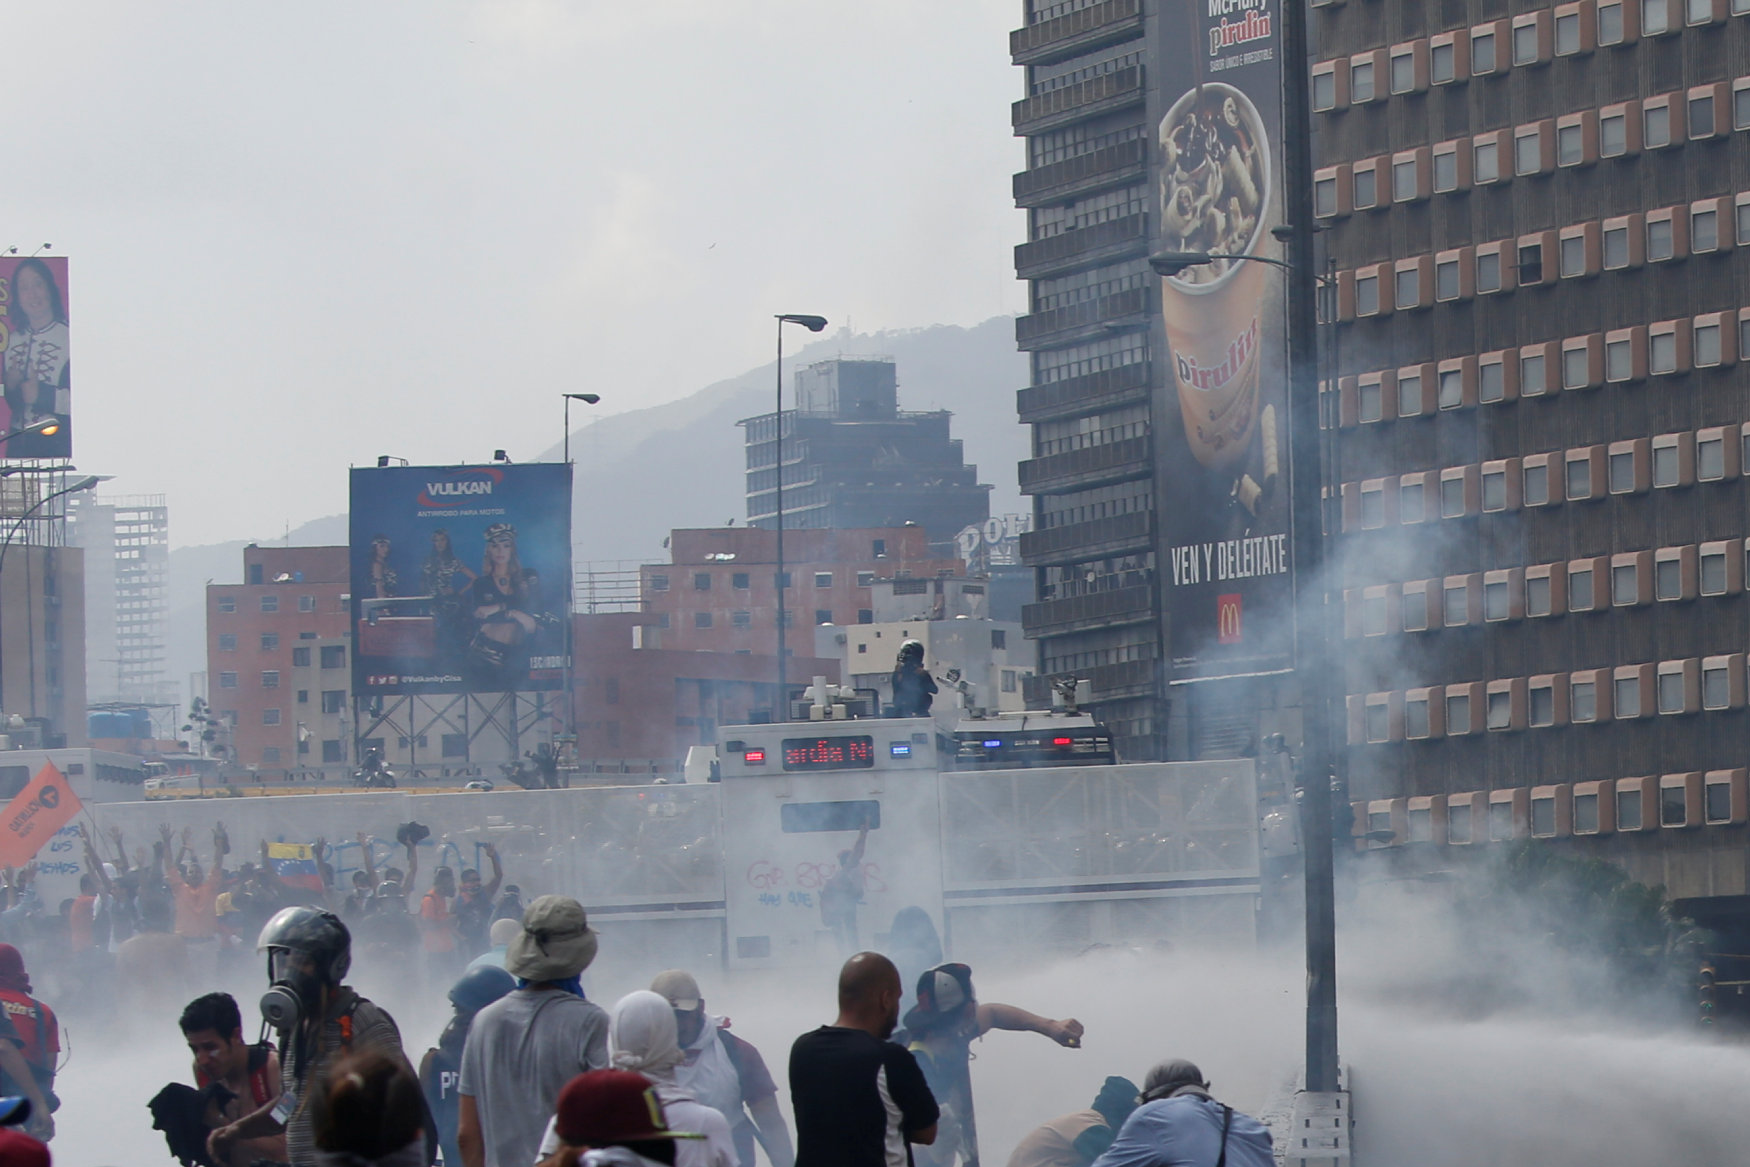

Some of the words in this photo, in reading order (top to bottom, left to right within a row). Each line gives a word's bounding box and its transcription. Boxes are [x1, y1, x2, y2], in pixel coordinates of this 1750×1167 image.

[1210, 10, 1271, 55] pirulin
[427, 481, 492, 496] VULKAN
[1171, 544, 1200, 586] VEN
[1203, 543, 1213, 582] Y
[1217, 528, 1287, 581] DELÉITATE
